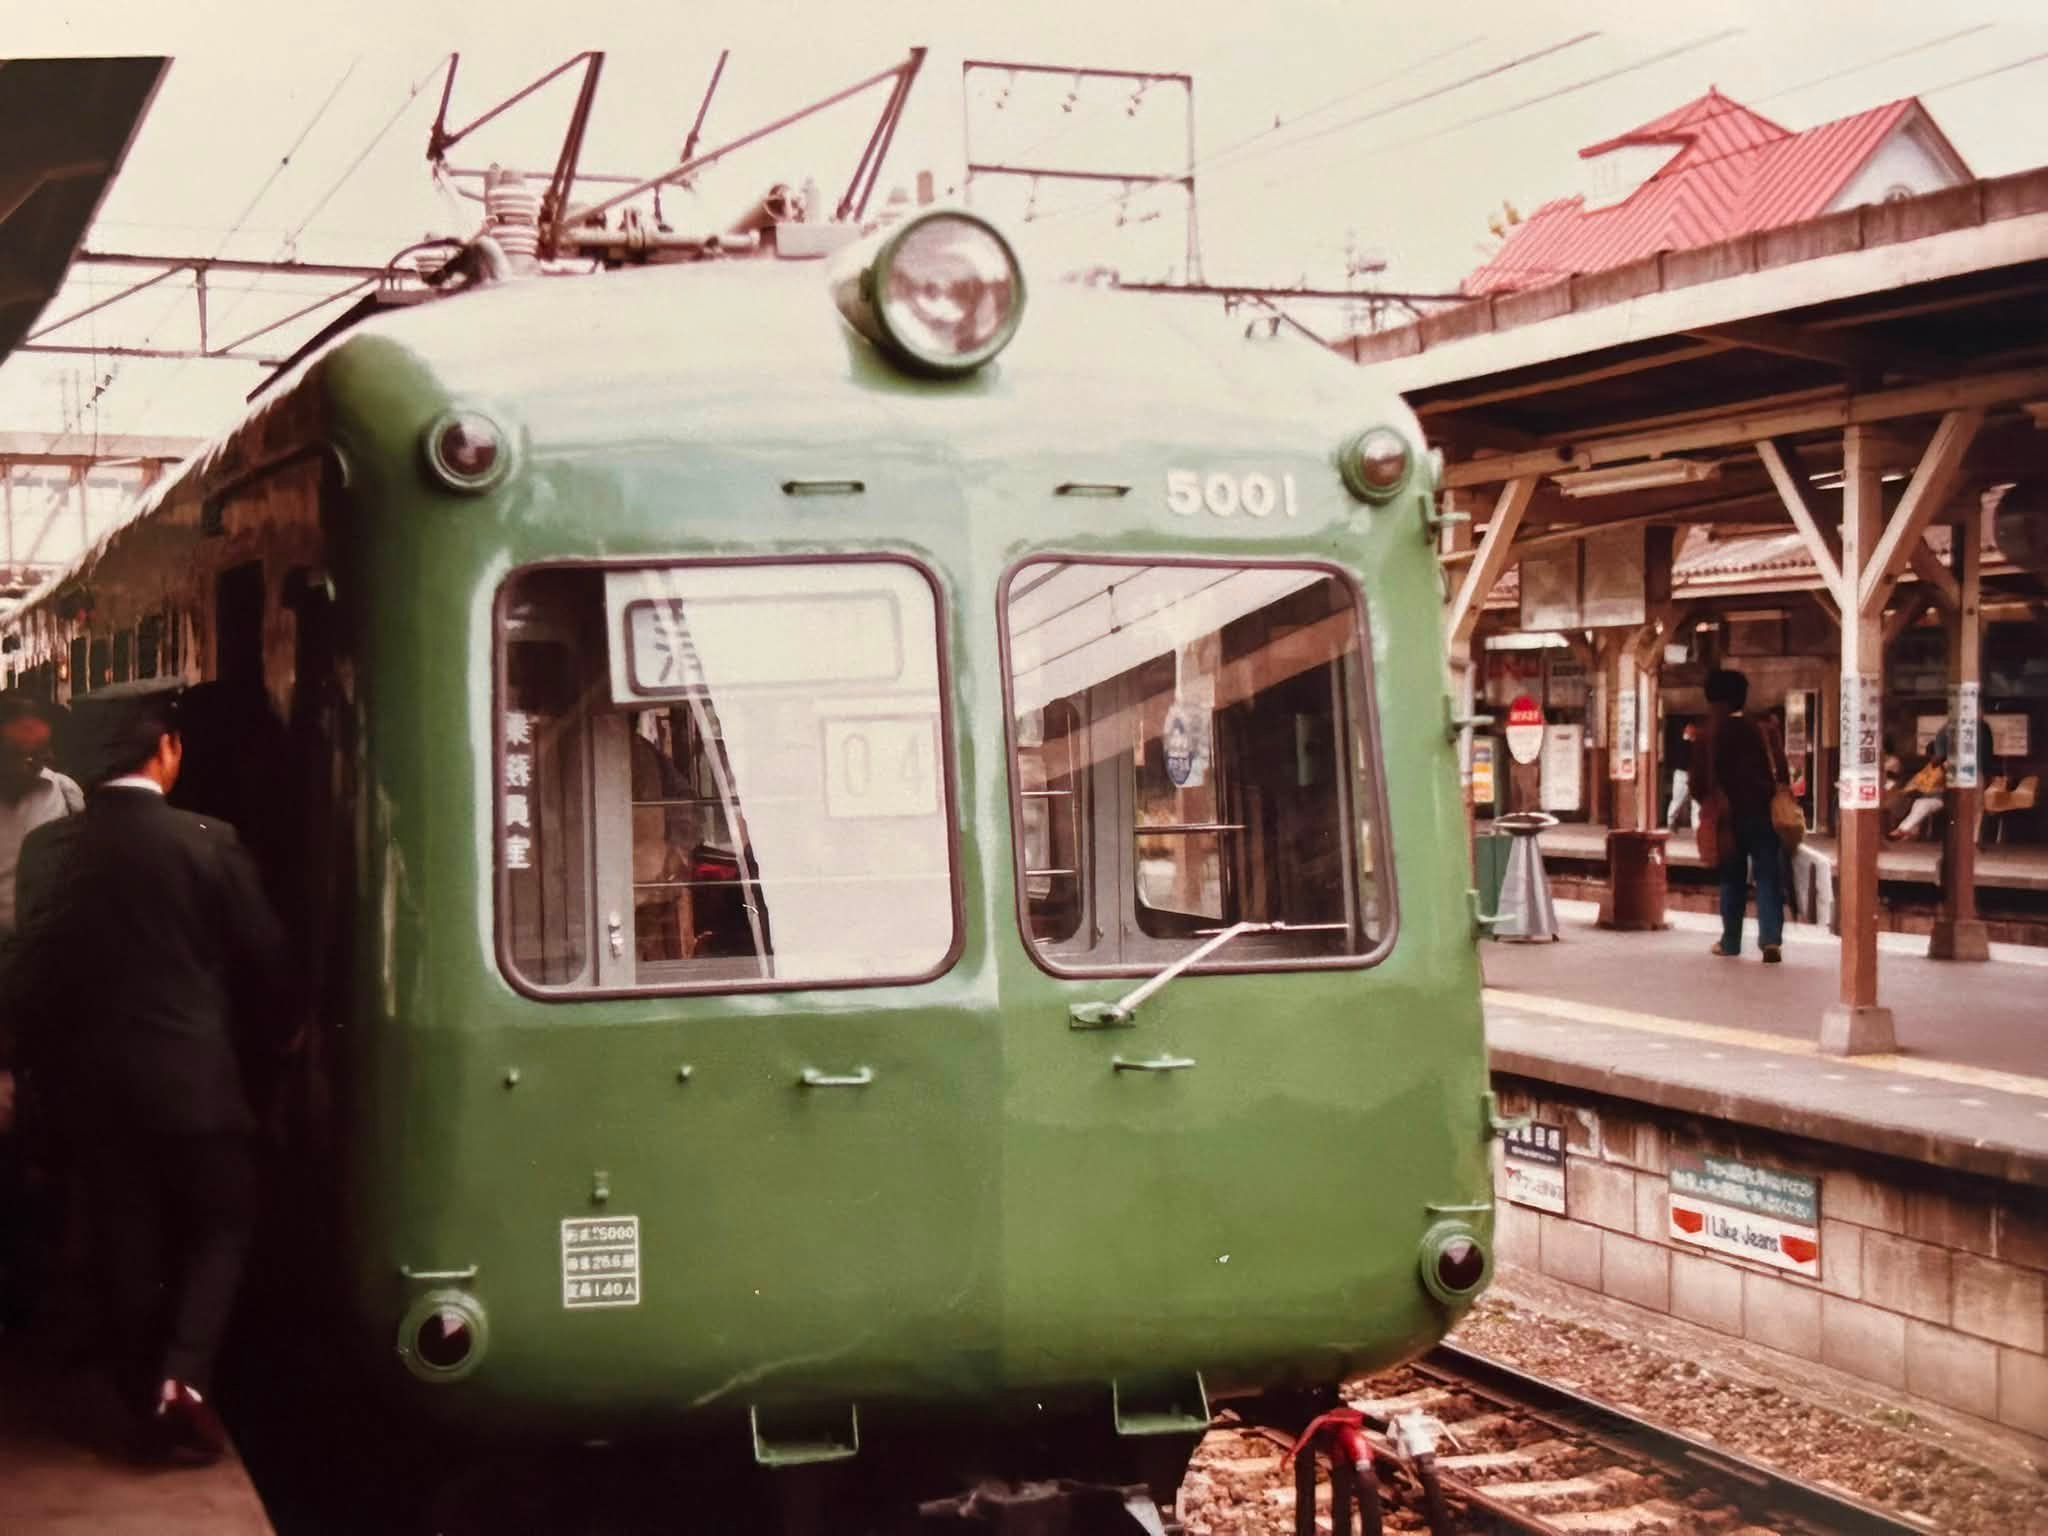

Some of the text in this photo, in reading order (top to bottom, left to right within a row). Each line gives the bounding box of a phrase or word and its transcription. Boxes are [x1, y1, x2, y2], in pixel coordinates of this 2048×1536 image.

[1167, 469, 1297, 518] 5001
[1711, 1214, 1740, 1242] Like
[1741, 1224, 1779, 1253] Jeans
